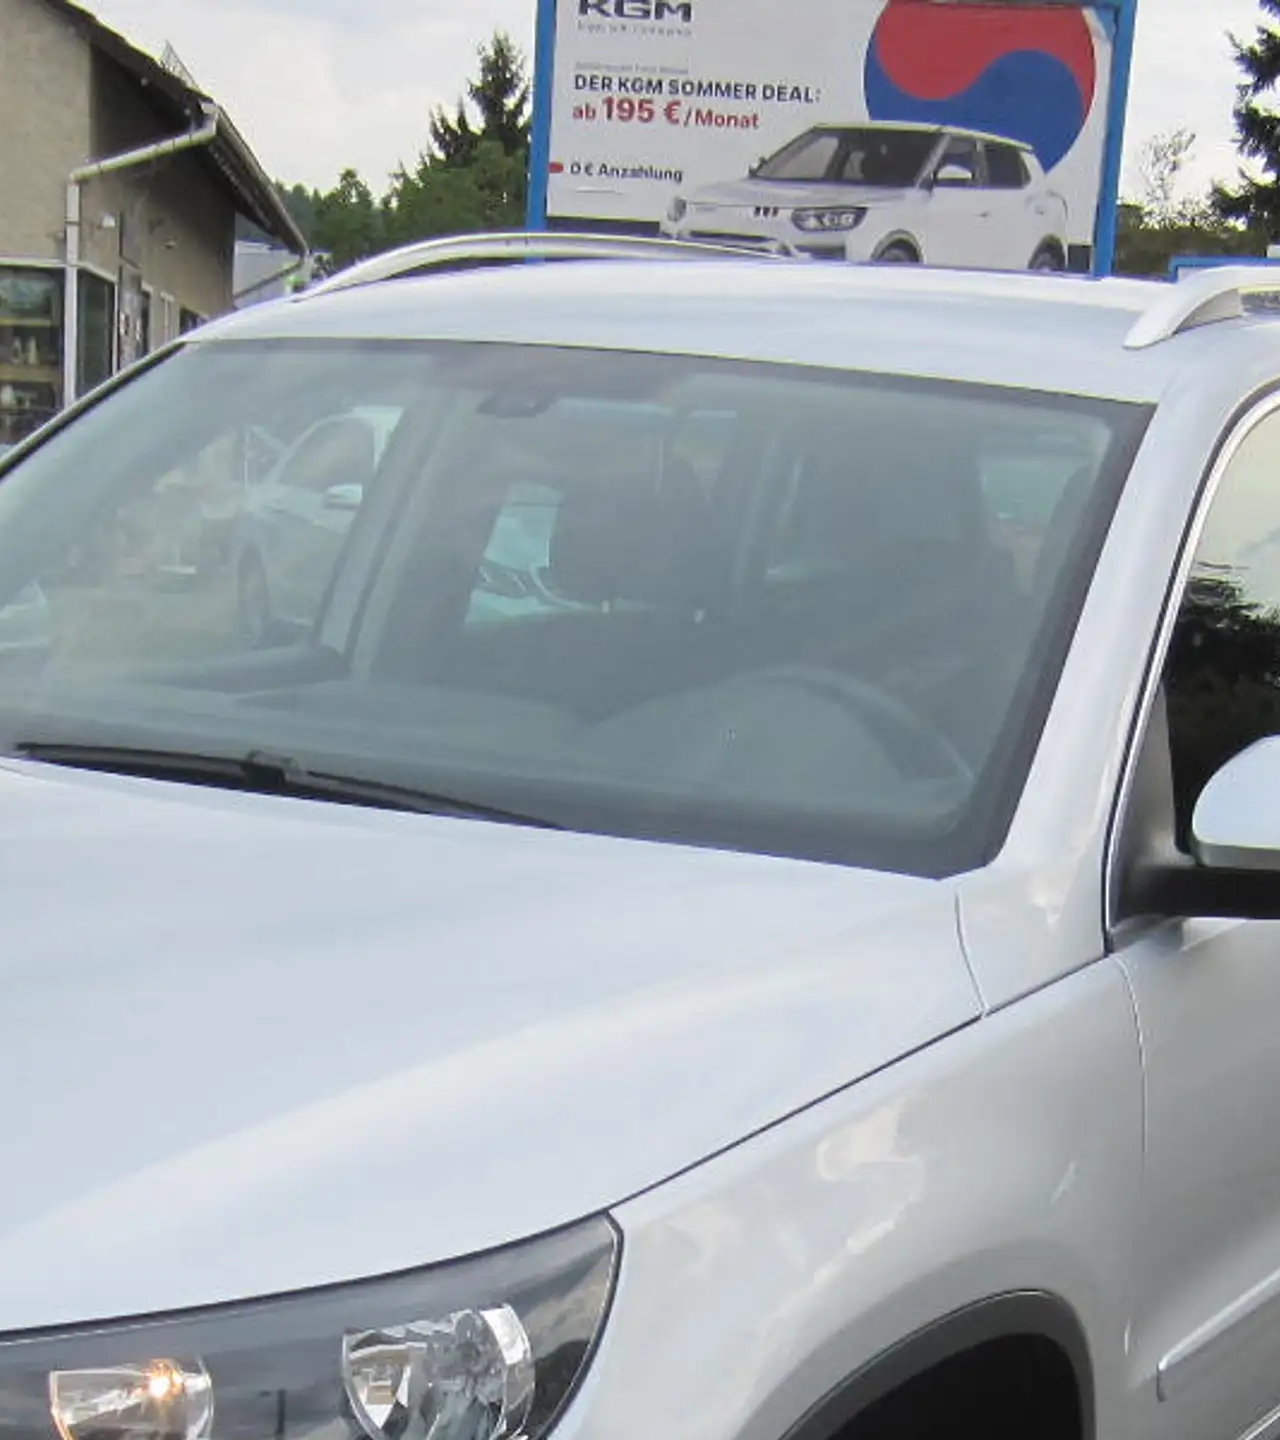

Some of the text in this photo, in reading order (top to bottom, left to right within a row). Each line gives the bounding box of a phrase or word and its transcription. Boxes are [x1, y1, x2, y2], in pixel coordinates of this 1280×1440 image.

[578, 0, 692, 22] KGM
[574, 74, 821, 103] DER KGM SOMMER DEAL:
[572, 103, 597, 121] ab
[602, 96, 656, 124] 195
[599, 163, 683, 183] Anzahlung
